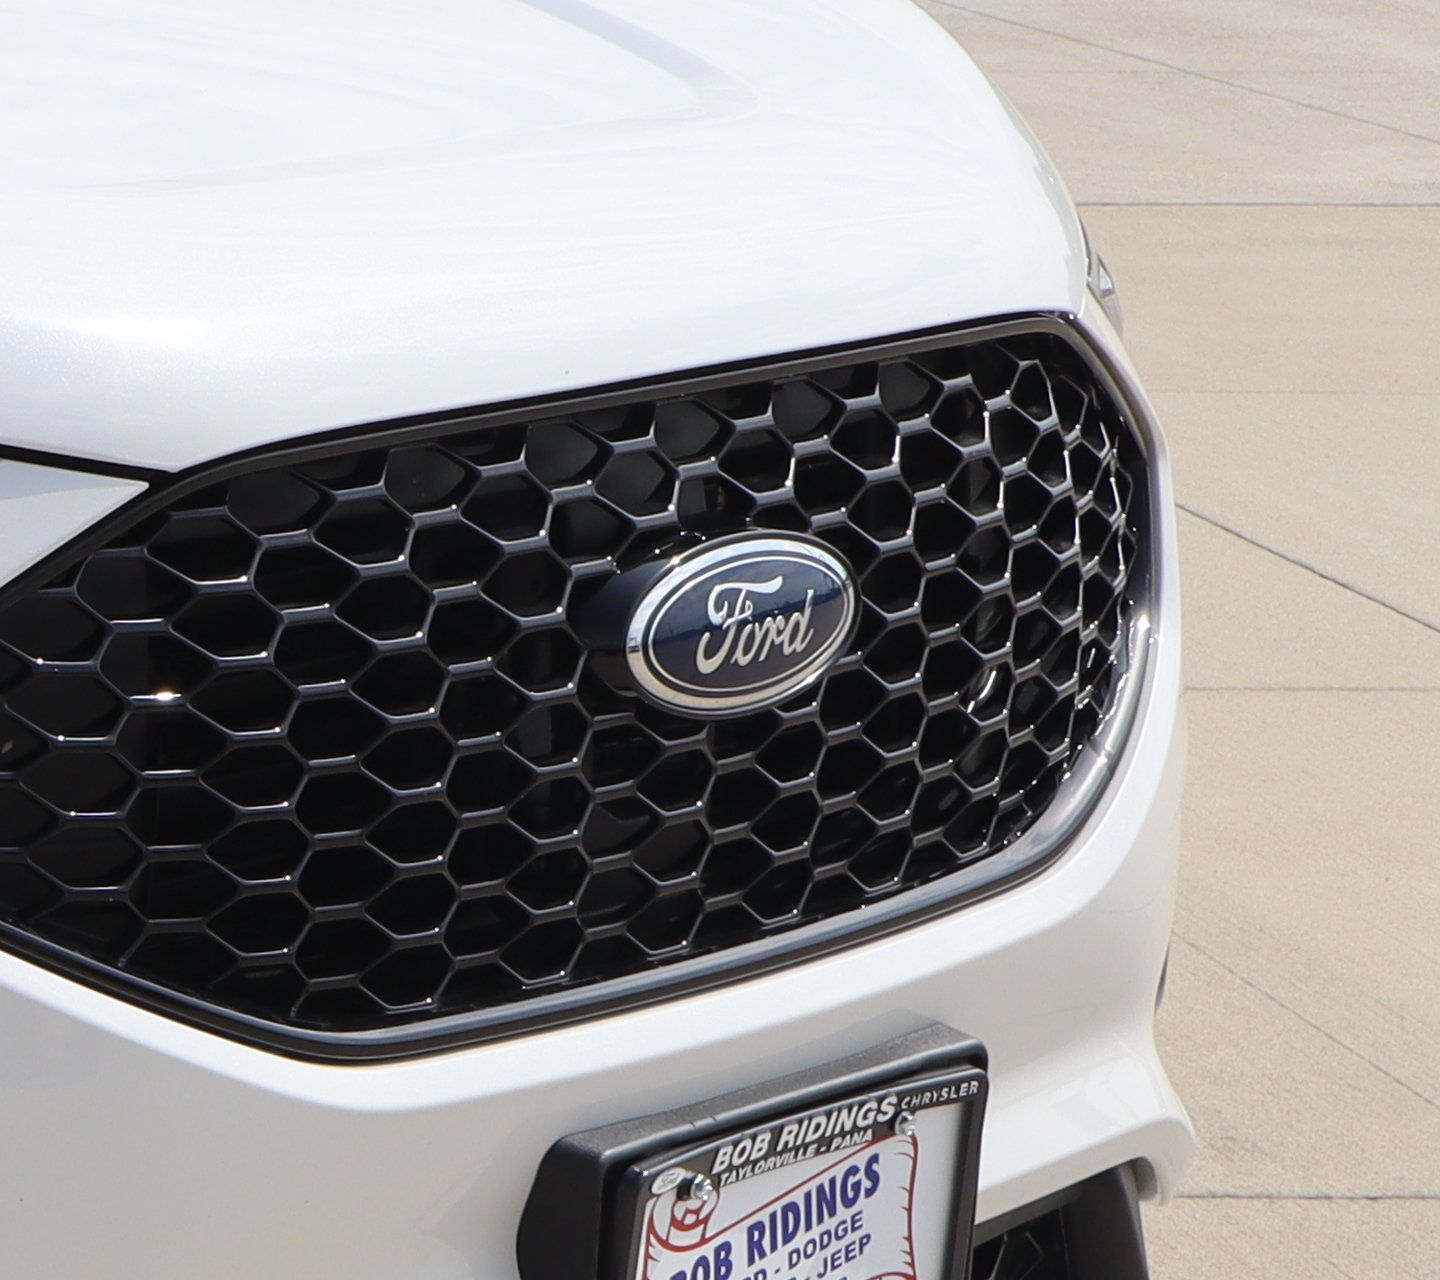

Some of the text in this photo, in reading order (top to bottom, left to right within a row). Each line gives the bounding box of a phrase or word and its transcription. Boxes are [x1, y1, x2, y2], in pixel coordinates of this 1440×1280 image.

[695, 575, 815, 675] Ford
[900, 1080, 979, 1111] CHRYSLER
[711, 1094, 899, 1175] BOB RIDINGS
[719, 1144, 818, 1187] TAYLORVILLE
[830, 1128, 874, 1152] PANA
[746, 1152, 881, 1268] RIDINGS
[788, 1209, 863, 1271] DODGE
[816, 1233, 872, 1280] JEEP
